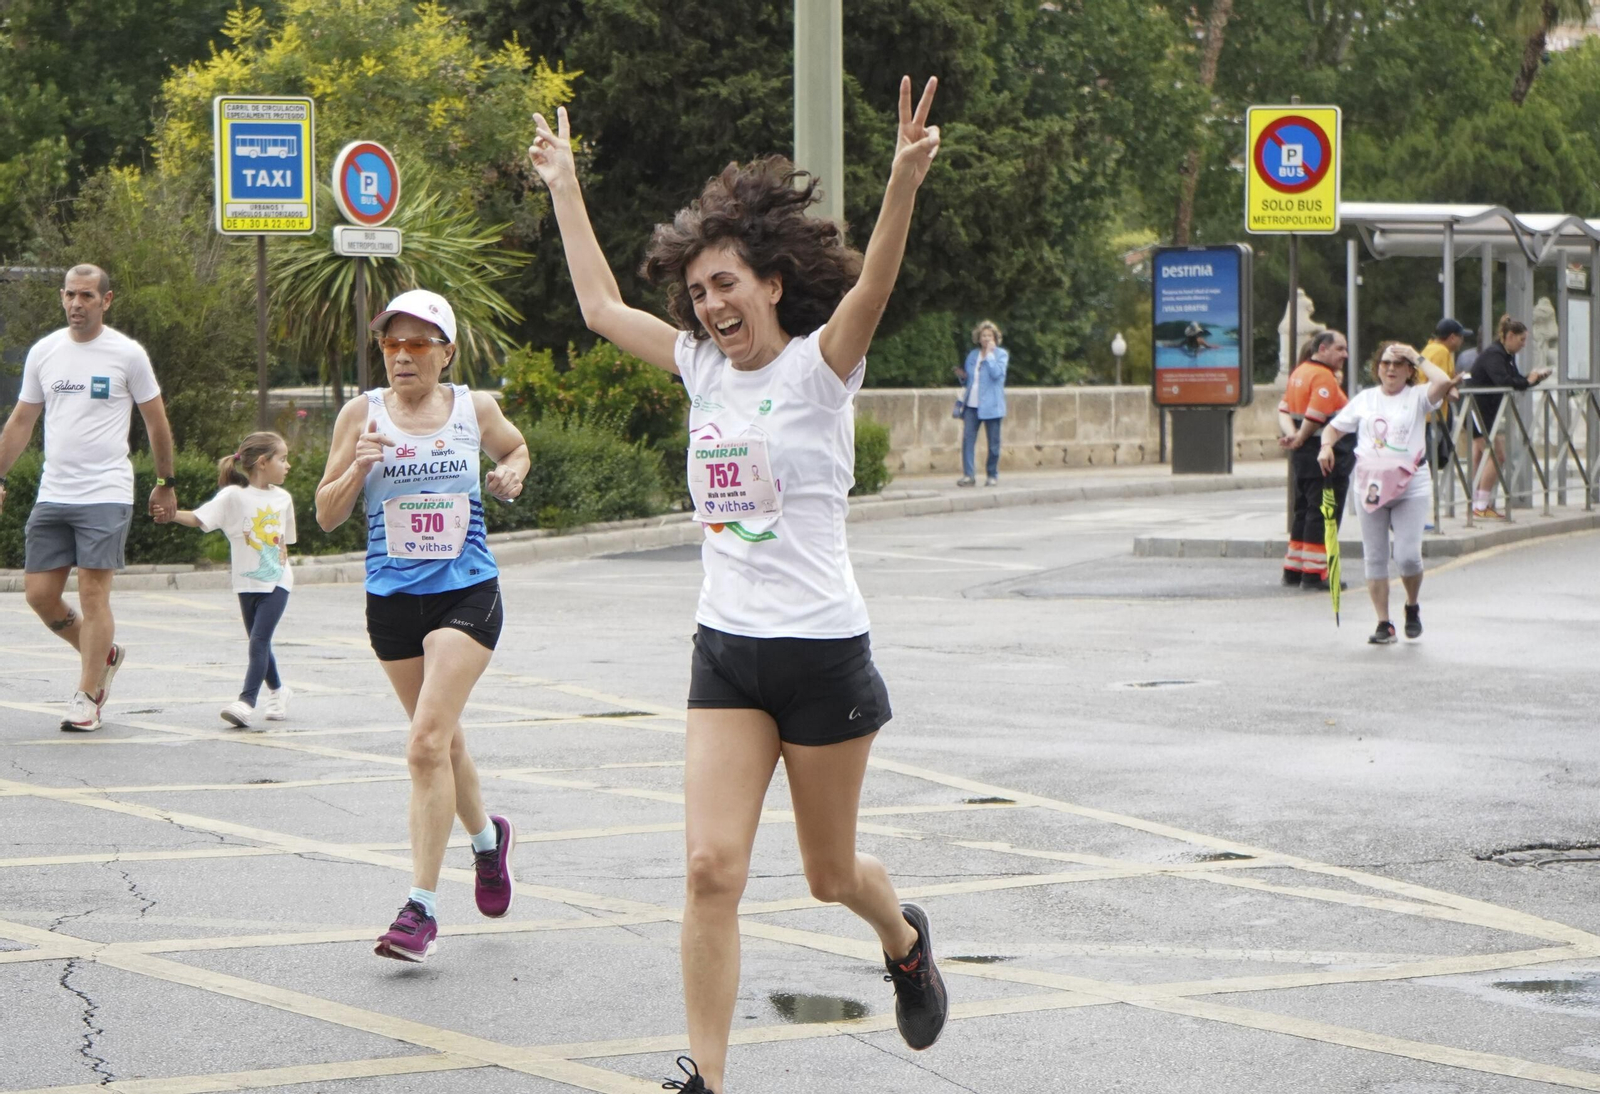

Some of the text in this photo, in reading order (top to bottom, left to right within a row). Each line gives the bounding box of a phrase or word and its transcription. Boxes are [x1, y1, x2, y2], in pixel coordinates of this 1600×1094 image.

[226, 104, 249, 112] CARRIL
[1287, 149, 1297, 162] P
[1279, 167, 1305, 177] BUS
[242, 170, 292, 187] TAXI
[364, 176, 373, 191] P
[361, 196, 378, 205] BUS
[1262, 200, 1322, 211] SOLO BUS
[227, 220, 238, 228] DE
[263, 220, 269, 228] A
[1253, 216, 1332, 225] METROPOLITANO
[348, 242, 393, 250] METROPOLITANO
[51, 380, 85, 392] Balance
[696, 447, 748, 459] COVIRAN
[383, 459, 468, 478] MARACENA
[706, 462, 741, 488] 752
[399, 502, 454, 510] COVIRAN
[718, 501, 755, 512] vithas
[411, 513, 444, 533] 570
[419, 543, 453, 552] vithas
